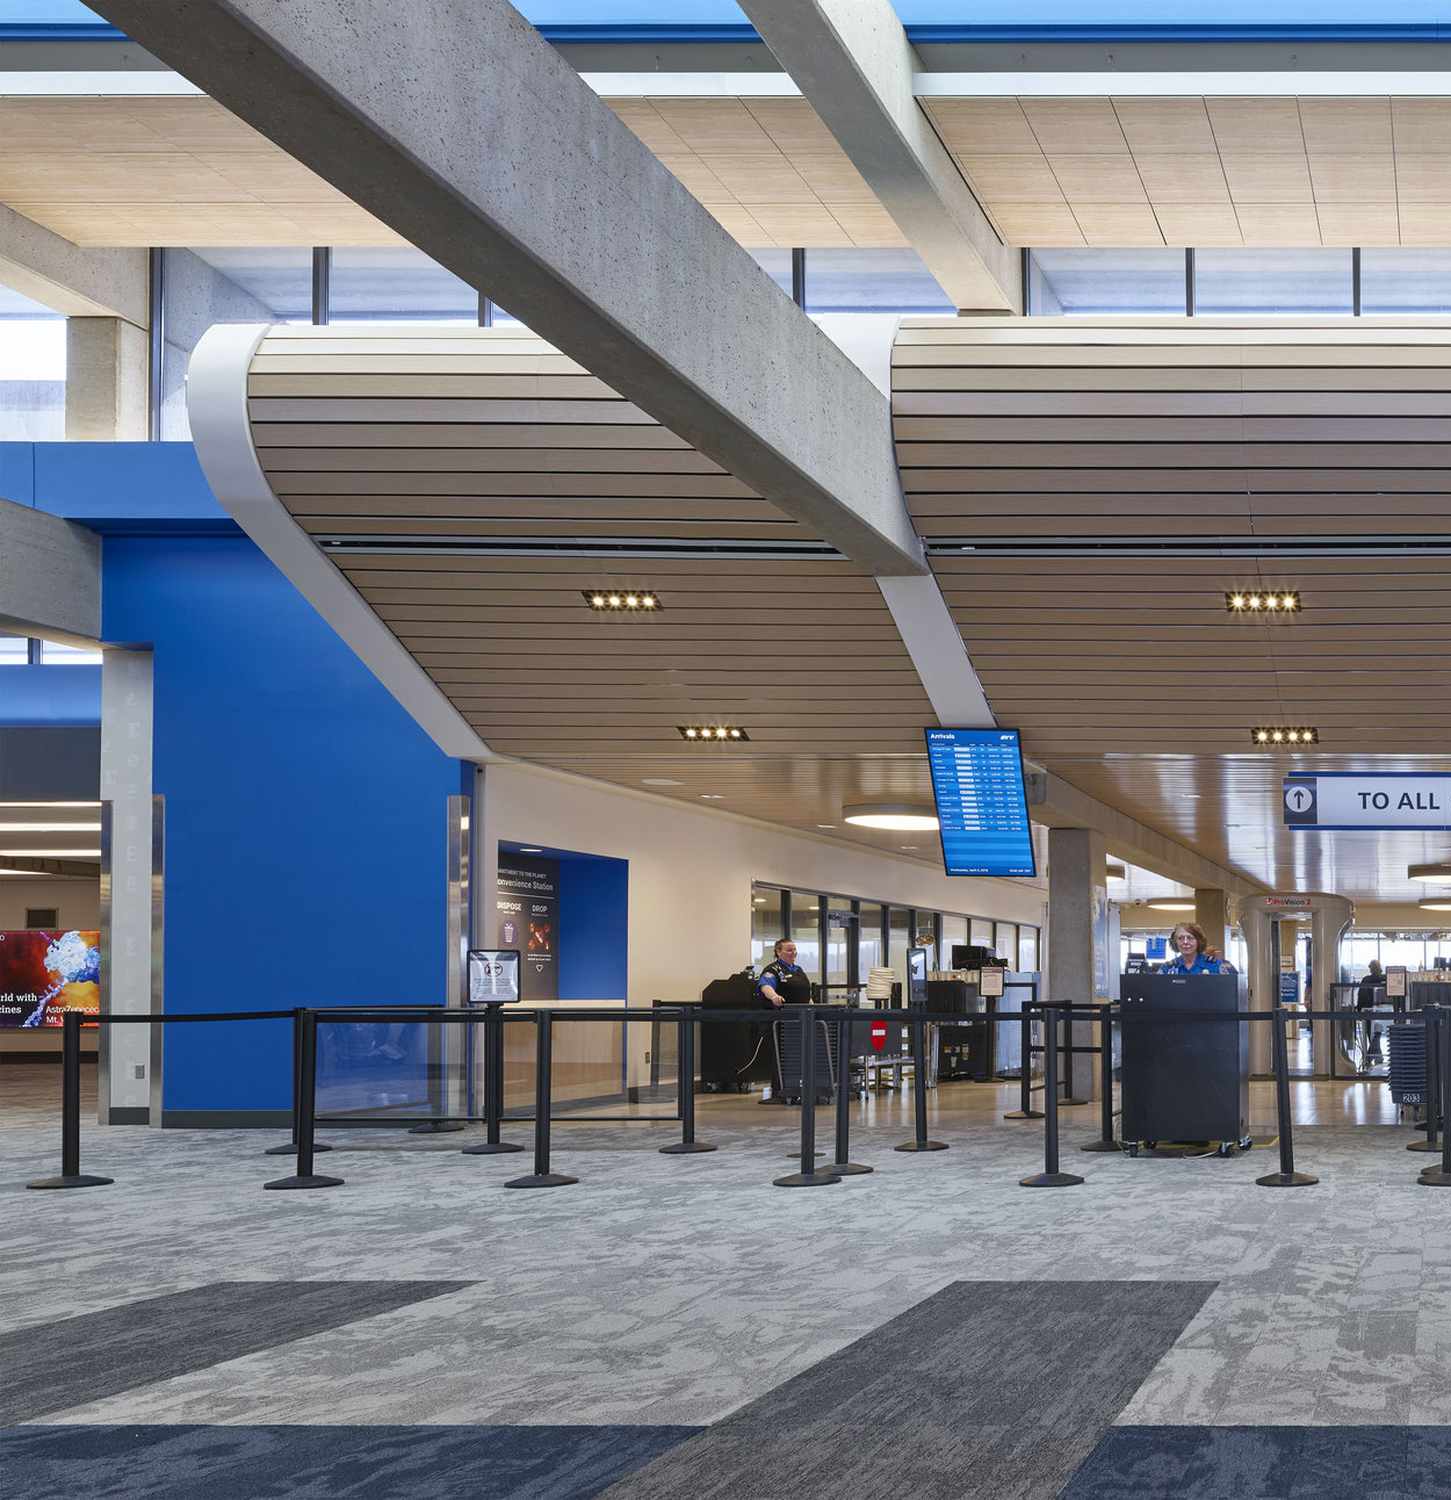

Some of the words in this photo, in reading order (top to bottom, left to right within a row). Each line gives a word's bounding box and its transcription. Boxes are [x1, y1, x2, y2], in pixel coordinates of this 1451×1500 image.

[1358, 792, 1389, 810] TO
[1398, 792, 1440, 810] ALL
[533, 881, 553, 890] Station
[532, 904, 548, 912] DROP
[16, 993, 37, 1001] with
[0, 1005, 21, 1013] ines
